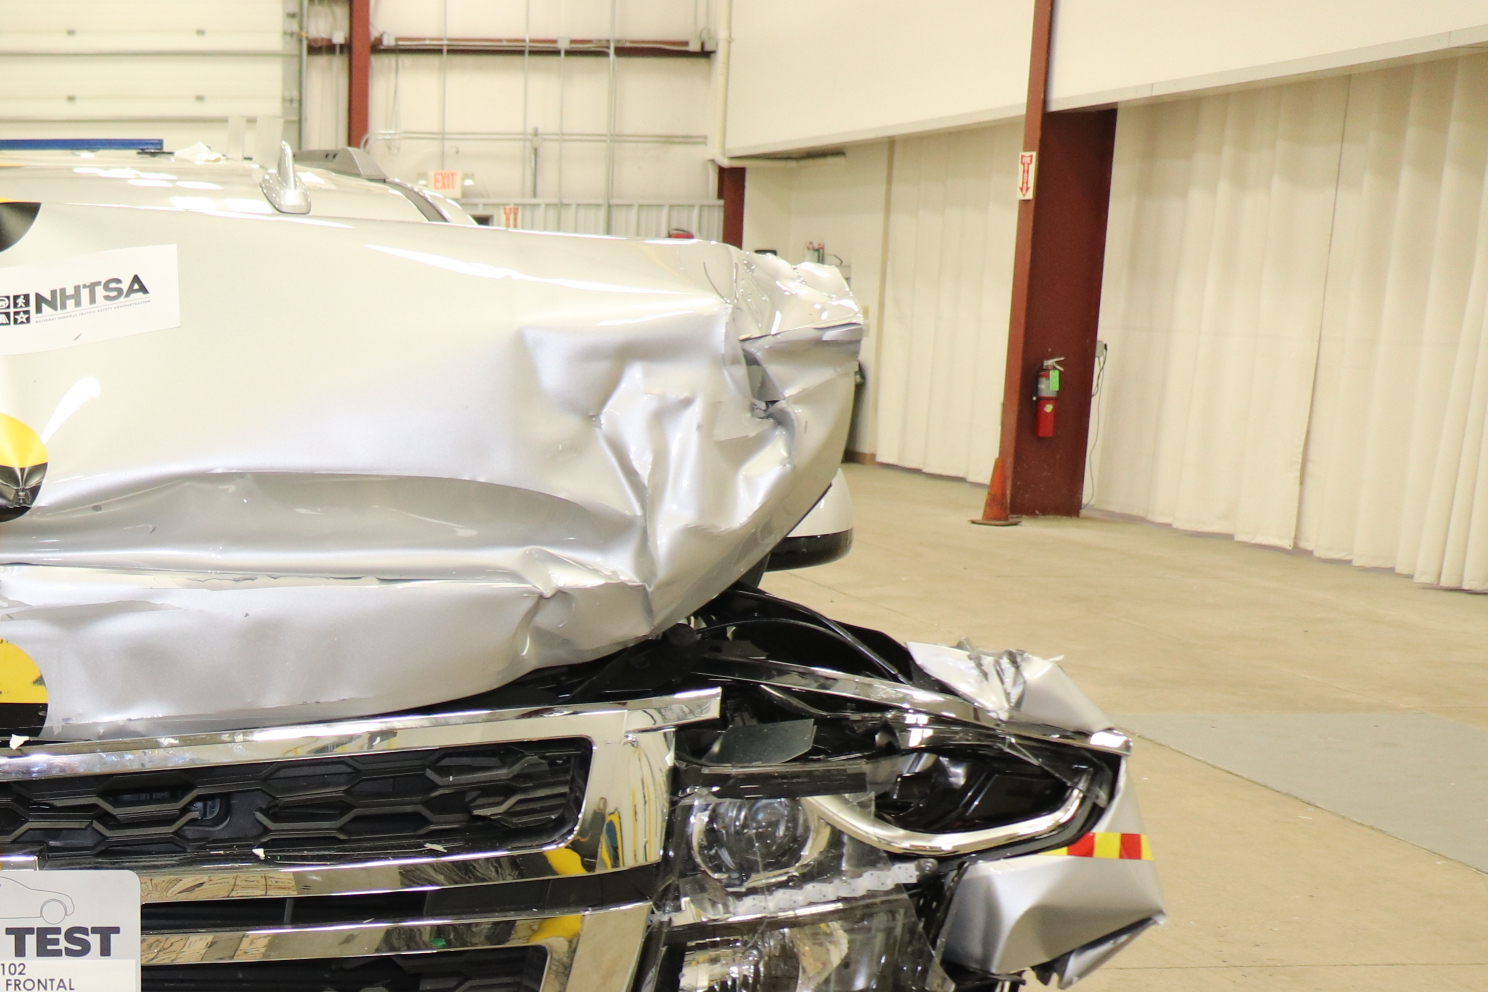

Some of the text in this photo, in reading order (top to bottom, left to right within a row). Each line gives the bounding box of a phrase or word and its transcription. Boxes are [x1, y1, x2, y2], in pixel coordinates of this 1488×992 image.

[433, 171, 459, 190] EXIT
[35, 274, 150, 314] NHTSA
[5, 926, 120, 957] TEST
[5, 978, 75, 991] FRONTAL
